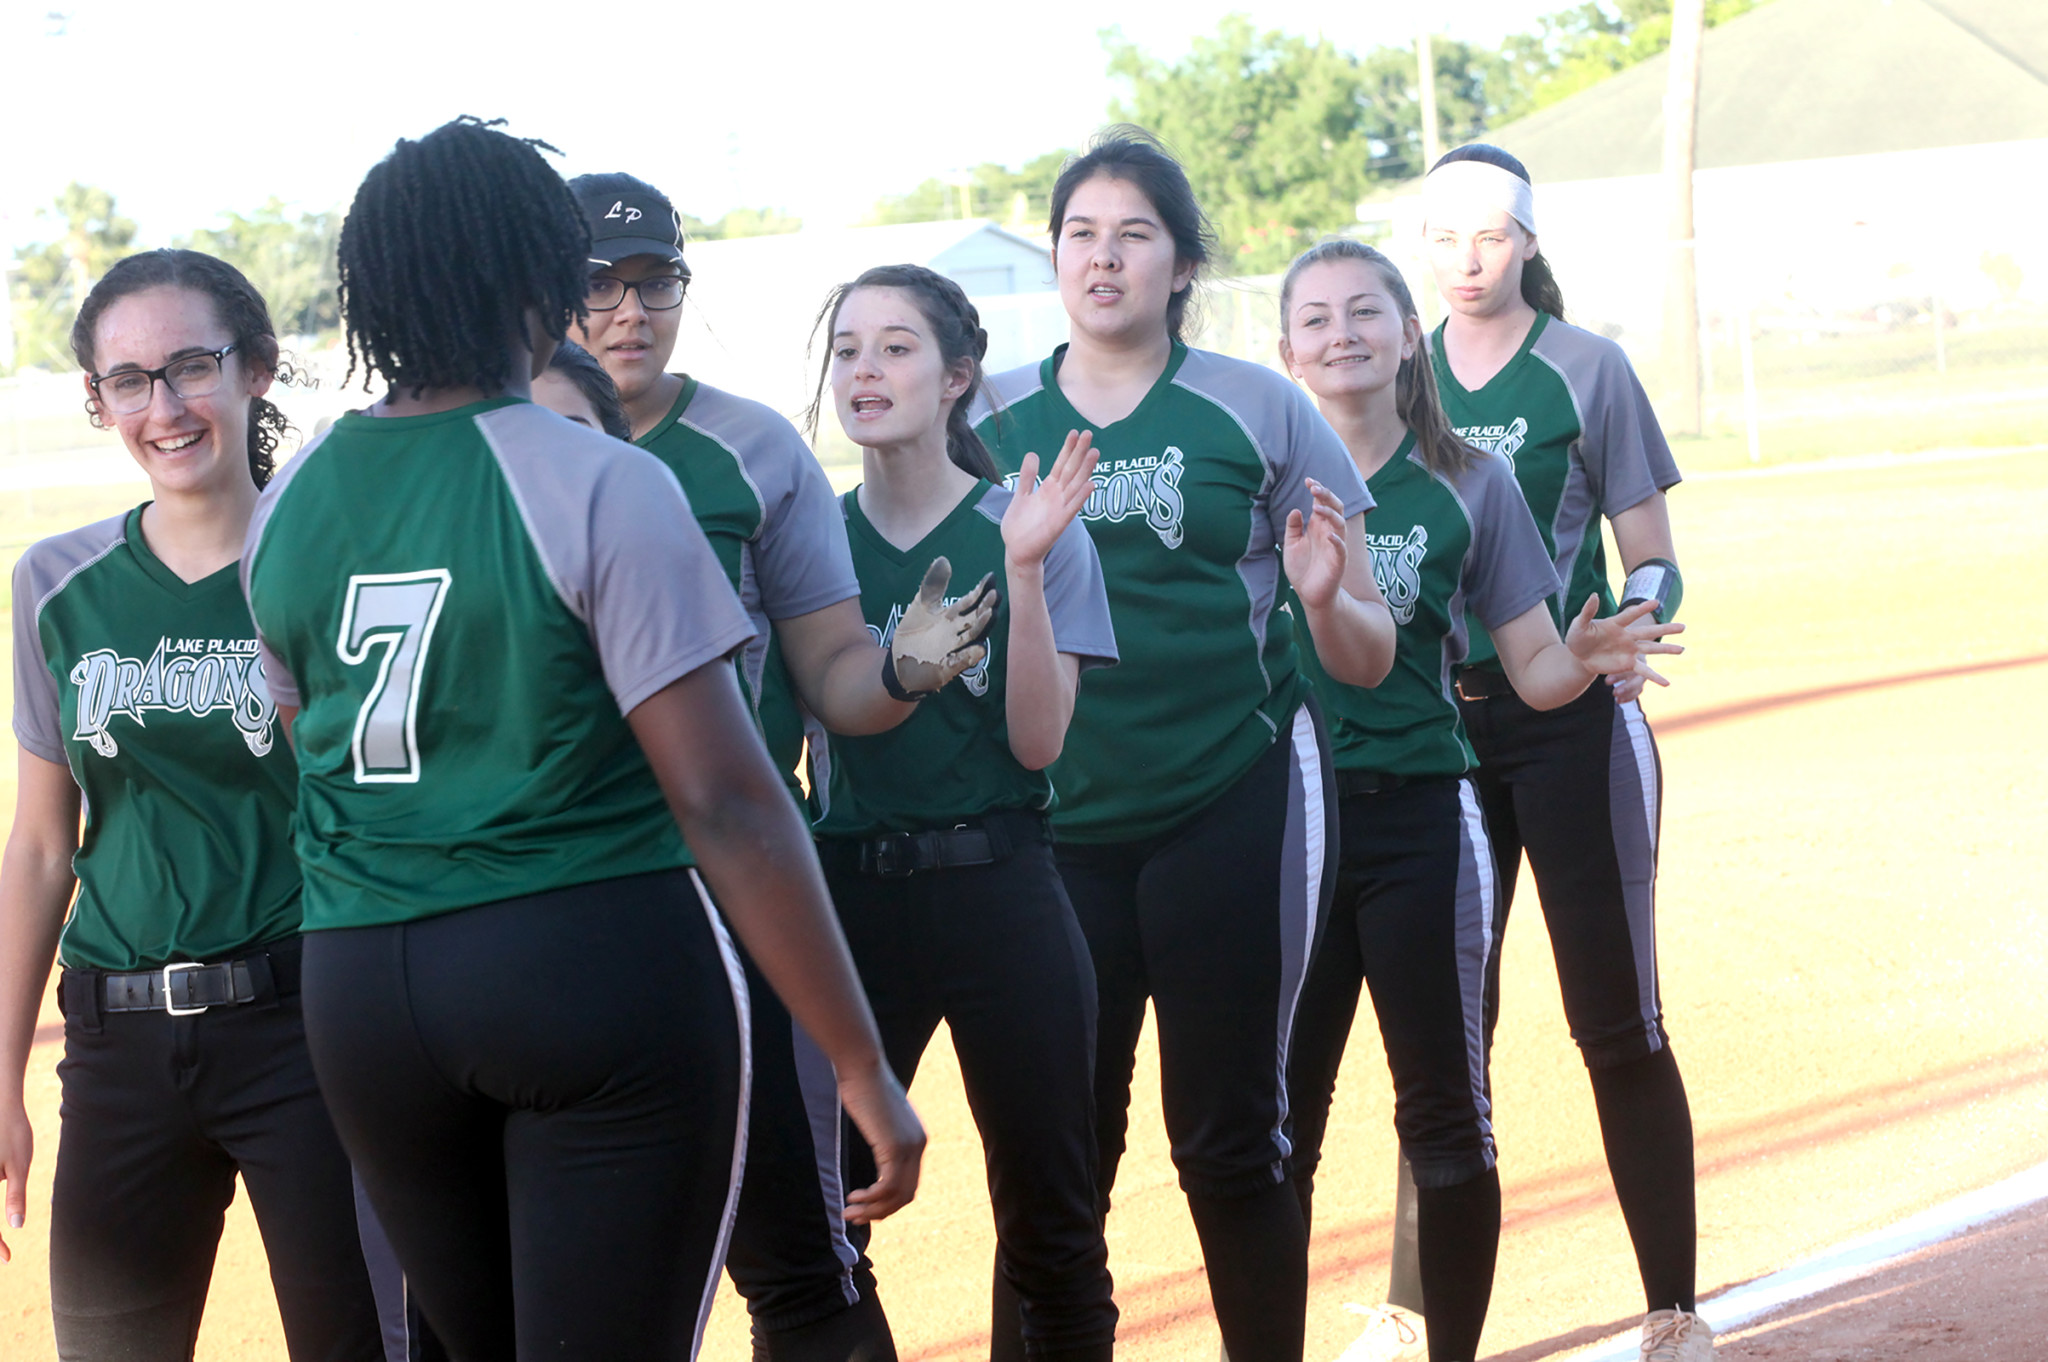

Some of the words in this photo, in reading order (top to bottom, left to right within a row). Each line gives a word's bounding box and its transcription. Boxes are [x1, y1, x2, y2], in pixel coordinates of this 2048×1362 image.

[1468, 425, 1505, 437] PLACID
[1114, 456, 1157, 471] PLACID
[1365, 533, 1403, 546] PLACID
[165, 637, 205, 653] LAKE
[207, 639, 259, 653] PLACID
[336, 568, 452, 784] 7
[70, 636, 278, 757] DRAGONS
